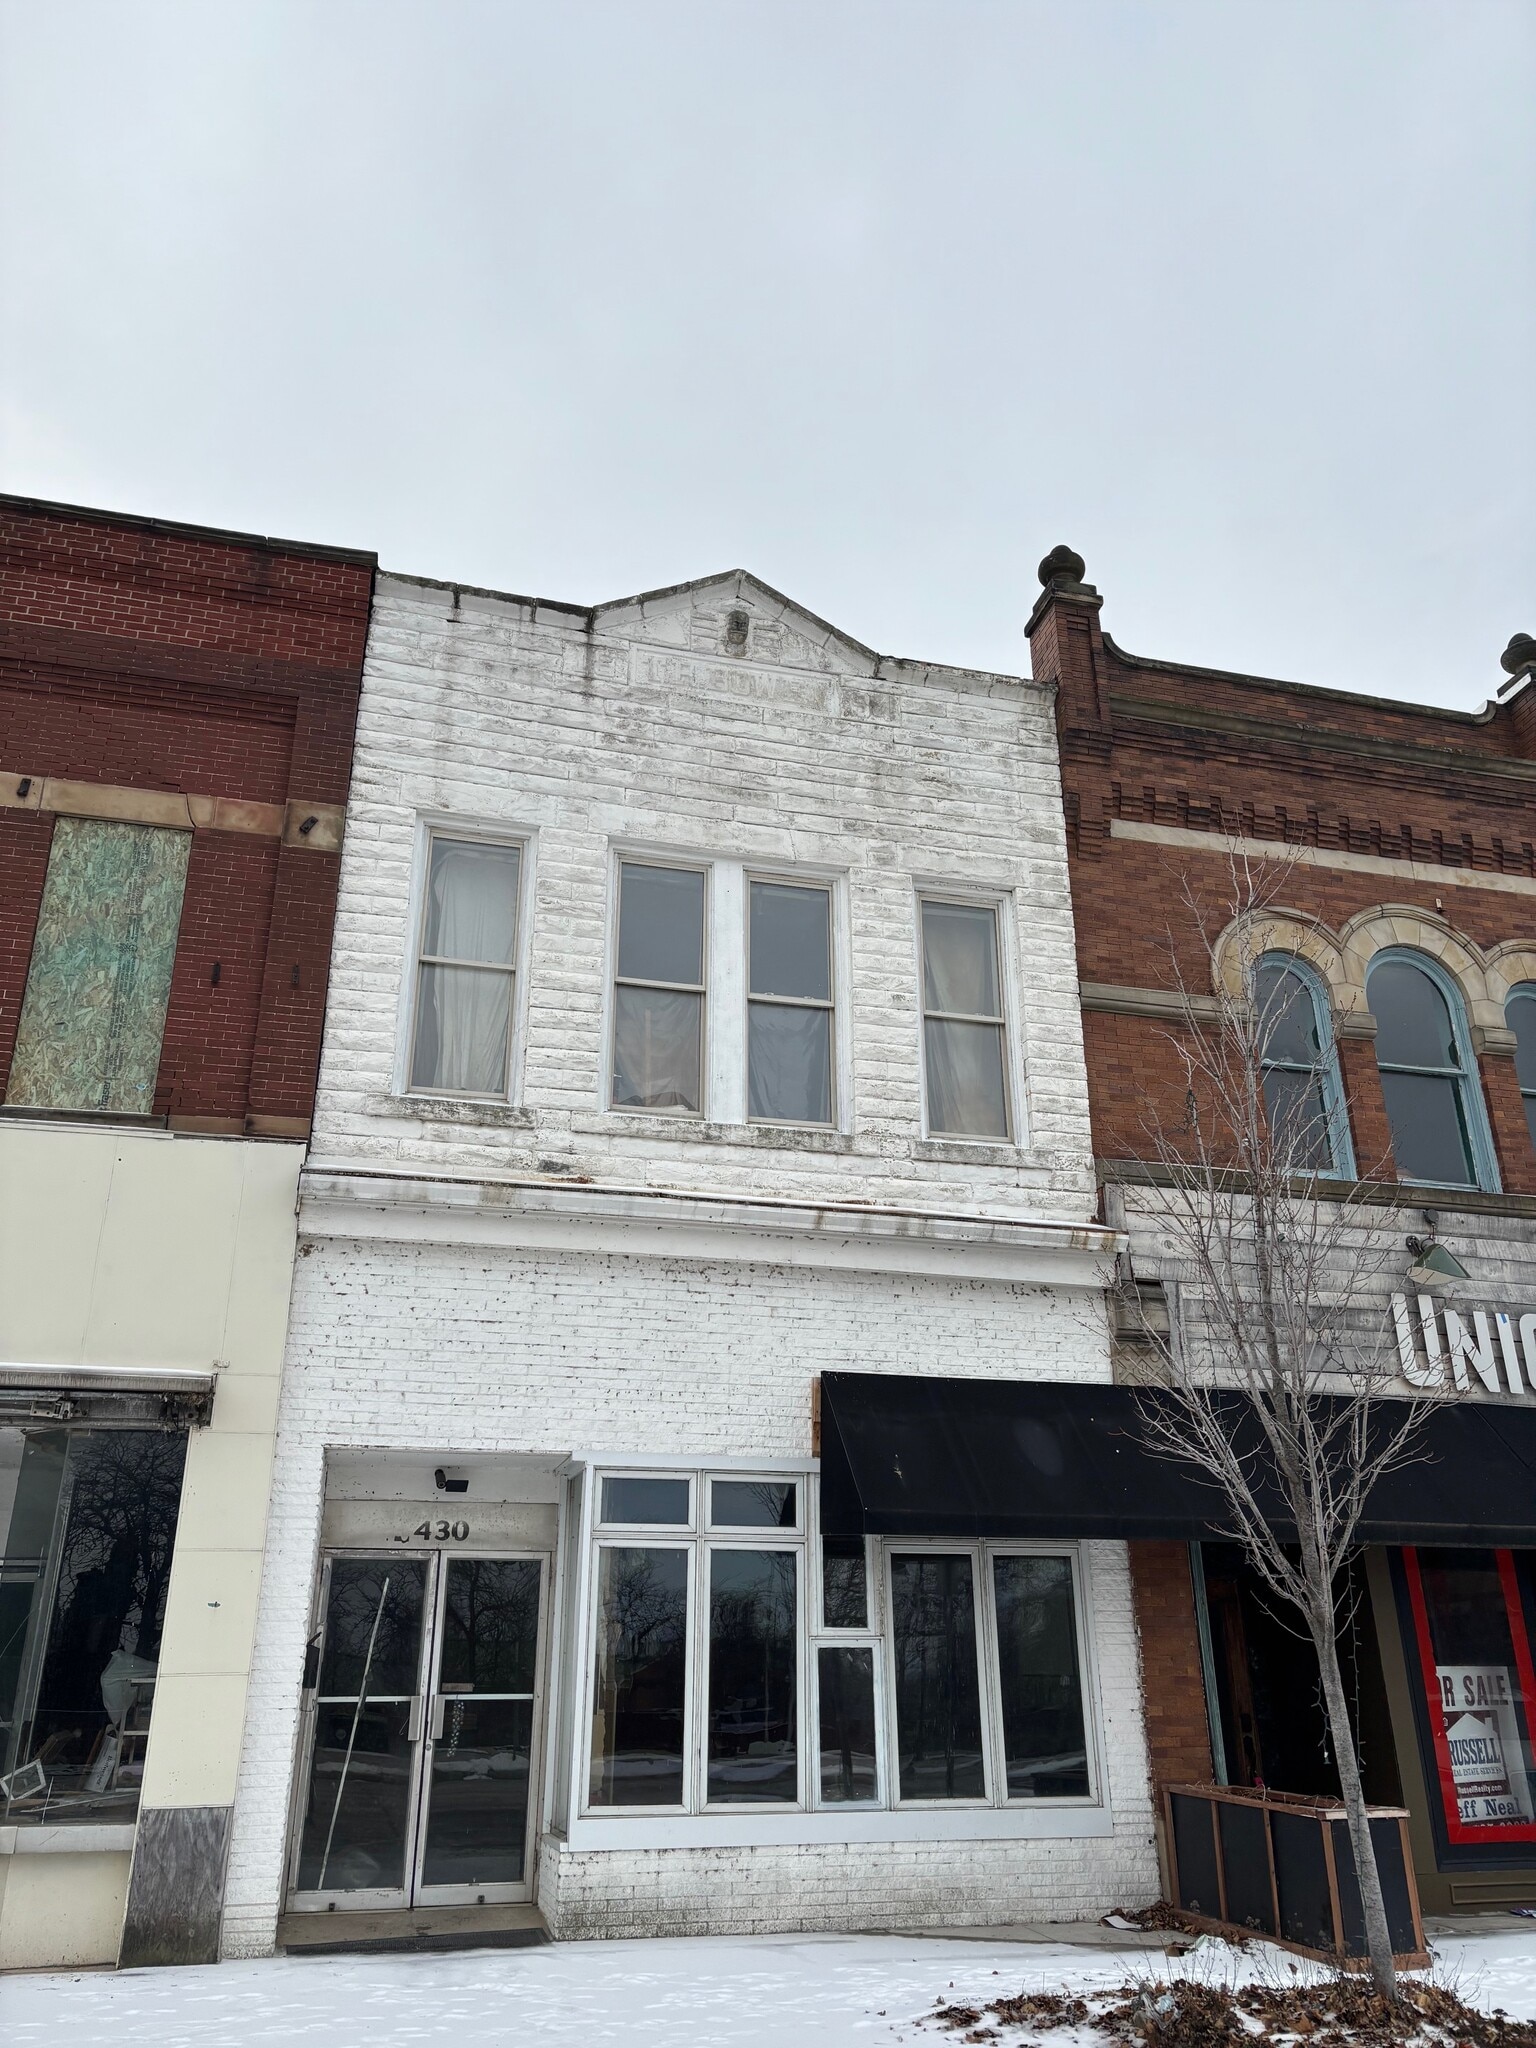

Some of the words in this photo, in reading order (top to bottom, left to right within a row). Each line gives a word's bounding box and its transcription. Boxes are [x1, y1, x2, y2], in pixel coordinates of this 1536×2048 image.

[413, 1520, 470, 1541] 430
[1463, 1675, 1509, 1707] SALE
[1448, 1738, 1502, 1766] RUSSELL
[1483, 1797, 1522, 1817] Neal
